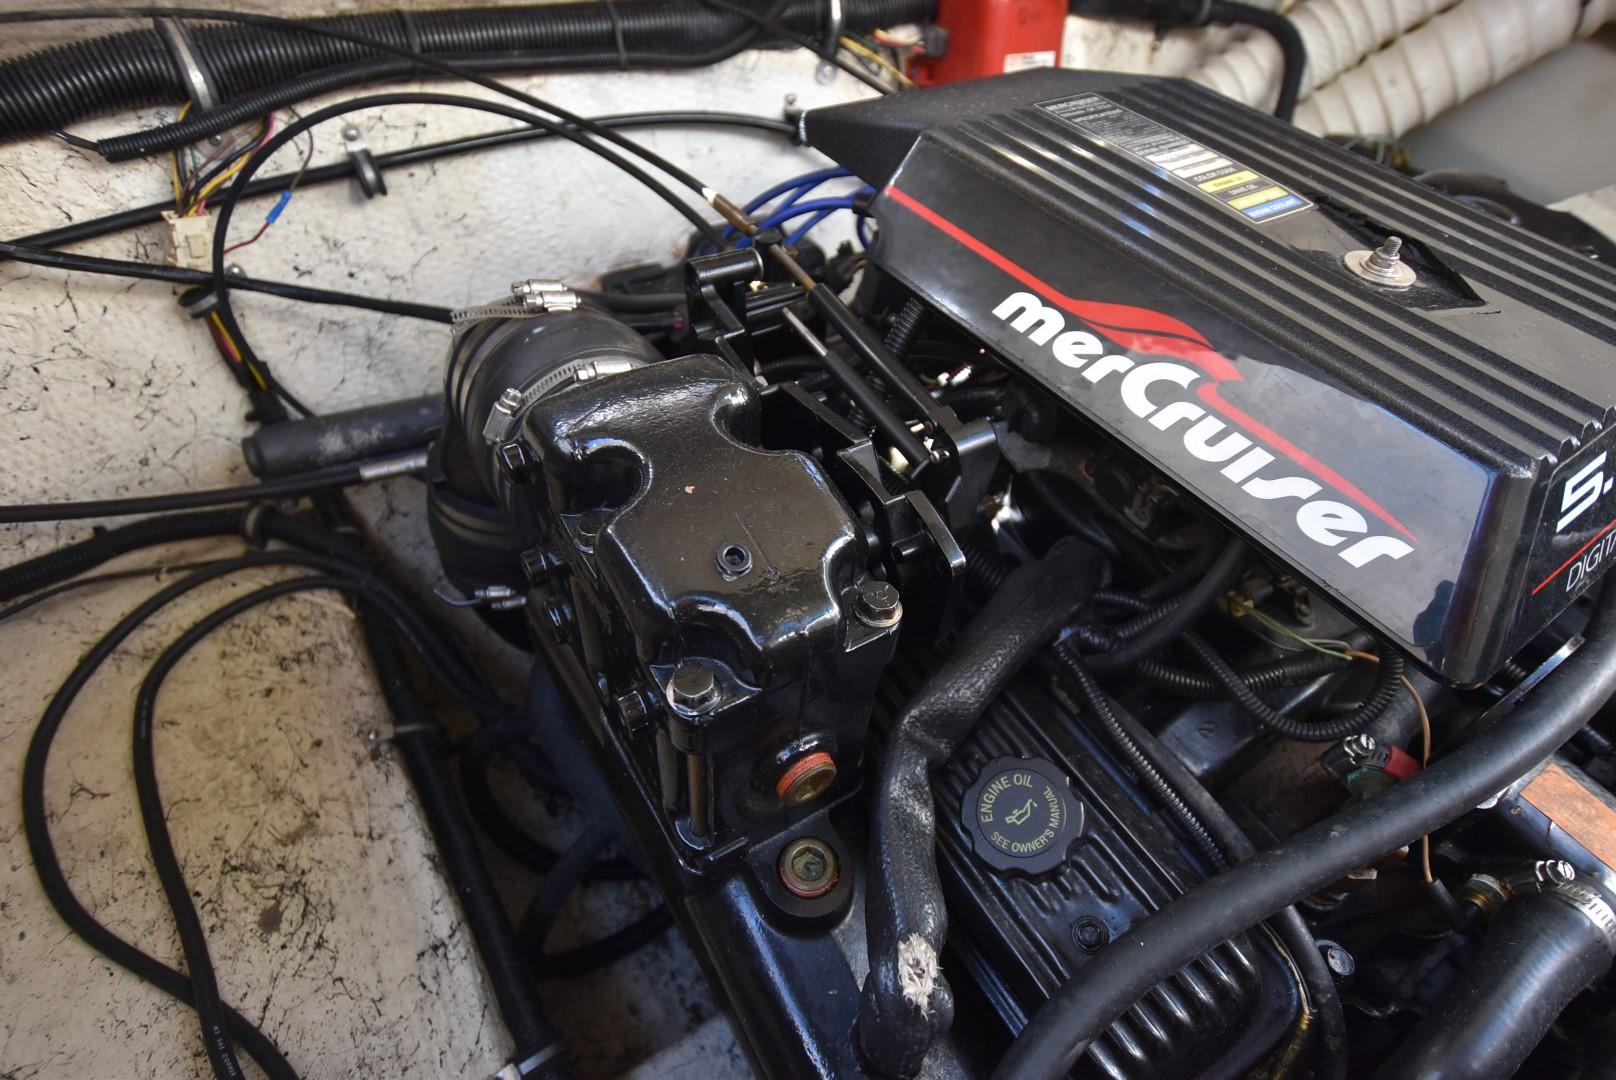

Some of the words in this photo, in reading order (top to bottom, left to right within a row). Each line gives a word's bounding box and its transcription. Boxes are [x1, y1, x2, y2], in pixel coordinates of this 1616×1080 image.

[981, 776, 1011, 823] ENGINE
[1013, 773, 1033, 788] OIL
[990, 831, 1009, 849] SEE
[1011, 828, 1055, 853] OWNER'S
[1043, 785, 1060, 829] MANUAL
